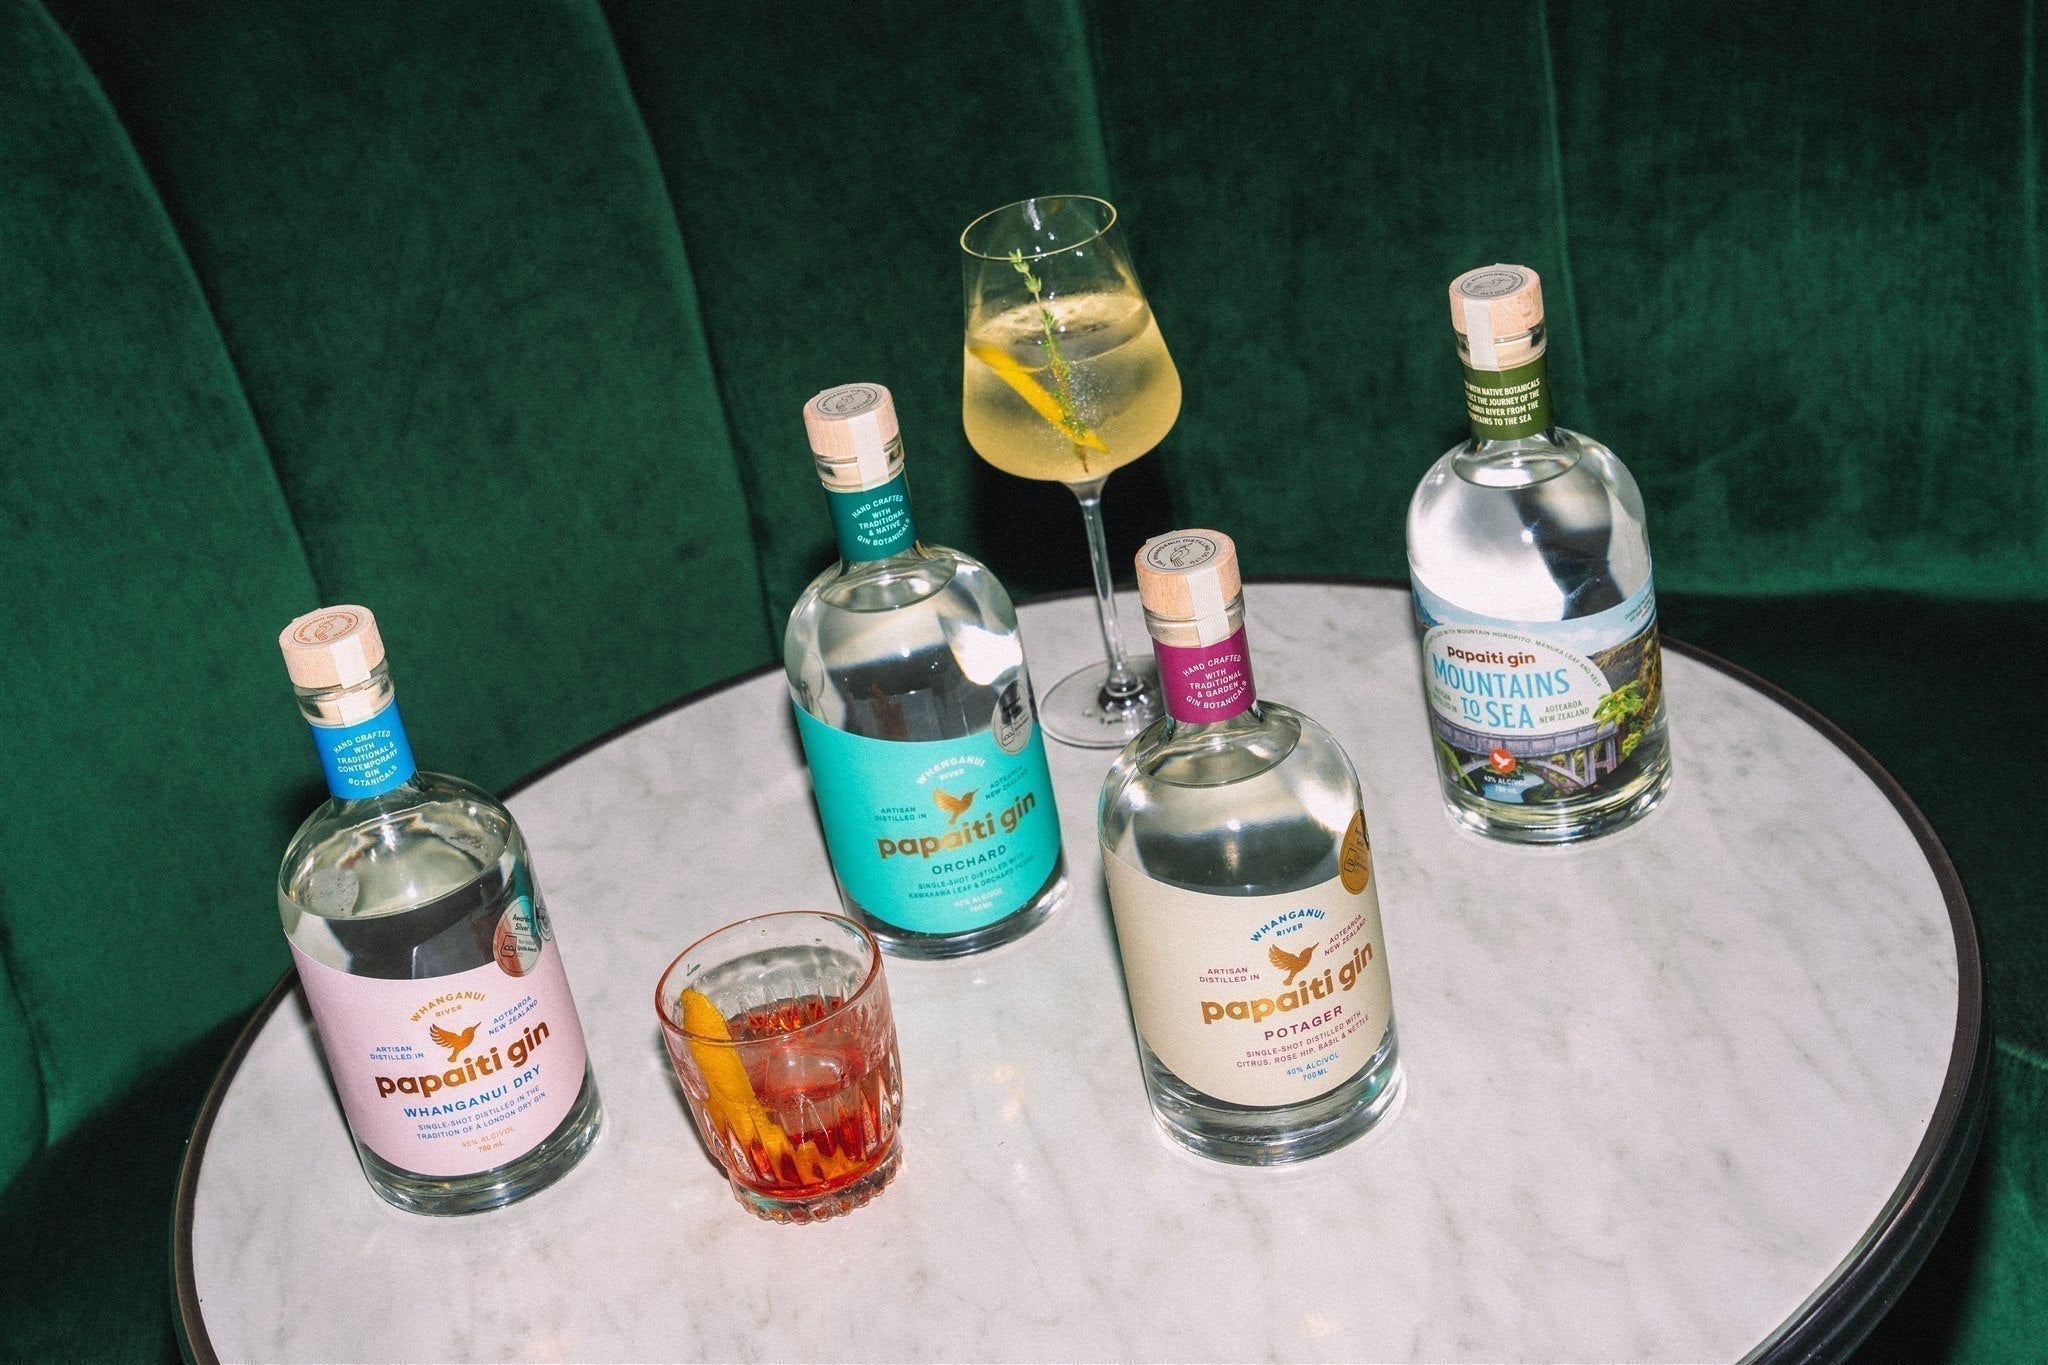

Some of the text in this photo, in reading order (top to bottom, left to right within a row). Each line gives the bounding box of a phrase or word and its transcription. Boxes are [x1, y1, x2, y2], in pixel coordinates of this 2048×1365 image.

[1477, 396, 1488, 405] THE
[1489, 396, 1519, 406] JOURNEY
[1520, 394, 1528, 402] OF
[1530, 389, 1540, 400] THE
[1482, 387, 1504, 396] NATIVE
[1504, 378, 1540, 395] BOTANICALS
[1486, 407, 1506, 416] RIVER
[1506, 405, 1526, 415] FROM
[1527, 400, 1538, 410] THE
[1504, 416, 1518, 426] THE
[1519, 414, 1532, 424] SEA
[852, 494, 904, 518] HAND CRAFTED
[872, 508, 891, 519] WITH
[858, 509, 904, 530] TRADITIONAL
[876, 520, 901, 534] NATIVE
[857, 518, 910, 546] GIN BOTANICALS
[1182, 654, 1241, 676] HAND CRAFTED
[1447, 646, 1536, 668] papaiti gin
[1492, 632, 1532, 644] HOROPITO,
[1565, 653, 1579, 664] LEAF
[1580, 664, 1591, 674] AND
[1591, 672, 1602, 687] KELP
[1190, 670, 1242, 690] TRADITIONAL
[1206, 668, 1226, 680] WITH
[1432, 652, 1570, 698] MOUNTAINS
[1186, 680, 1247, 709] GIN BOTANICALS
[1206, 681, 1238, 698] GARDEN
[1460, 696, 1480, 716] TO
[1486, 701, 1534, 728] SEA
[1539, 708, 1590, 724] NEW ZEALAND
[1545, 700, 1582, 714] AOTEAROA
[333, 730, 390, 754] HAND CRAFTED
[353, 742, 374, 753] WITH
[337, 746, 388, 764] TRADITIONAL
[338, 748, 398, 772] CONTEMPORARY
[348, 764, 397, 786] BOTANICALS
[365, 768, 380, 778] GIN
[916, 756, 986, 784] WHANGANUI
[939, 768, 964, 781] RIVER
[986, 788, 1001, 800] NEW
[877, 792, 1036, 859] papaiti gin
[932, 844, 1006, 876] ORCHARD
[908, 889, 950, 899] KAWAKAWA
[953, 884, 972, 894] LEAF
[981, 868, 1013, 887] ORCHARD
[918, 876, 969, 890] SINGLE-SHOT
[972, 862, 1008, 880] DISTILLED
[1250, 908, 1326, 942] WHANGANUI
[1276, 923, 1303, 937] RIVER
[1324, 918, 1366, 956] NEW ZEALAND
[1329, 914, 1362, 944] AOTEAROA
[1200, 976, 1246, 984] DISTILLED
[1201, 943, 1372, 1024] papaiti gin
[410, 991, 486, 1022] WHANGANUI
[435, 1004, 462, 1018] RIVER
[488, 1000, 538, 1036] NEW ZEALAND
[493, 996, 532, 1024] AOTEAROA
[1246, 1010, 1362, 1058] SINGLE-SHOT DISTILLED WITH
[1264, 1005, 1343, 1040] POTAGER
[1236, 1060, 1272, 1068] CITRUS,
[1274, 1053, 1298, 1064] ROSE
[1300, 1047, 1316, 1056] HIP,
[1318, 1037, 1340, 1050] BASIL
[1347, 1014, 1370, 1034] NETTLE
[375, 1022, 550, 1098] papaiti gin
[1286, 1052, 1340, 1076] 40% ALC/VOL
[403, 1064, 541, 1118] WHANGANUI DRY
[416, 1129, 460, 1140] TRADITION
[462, 1126, 474, 1134] OF
[484, 1110, 516, 1127] LONDON
[518, 1101, 532, 1112] DRY
[534, 1092, 546, 1103] GIN
[418, 1116, 472, 1131] SINGLE-SHOT
[476, 1100, 516, 1120] DISTILLED
[526, 1085, 540, 1096] THE
